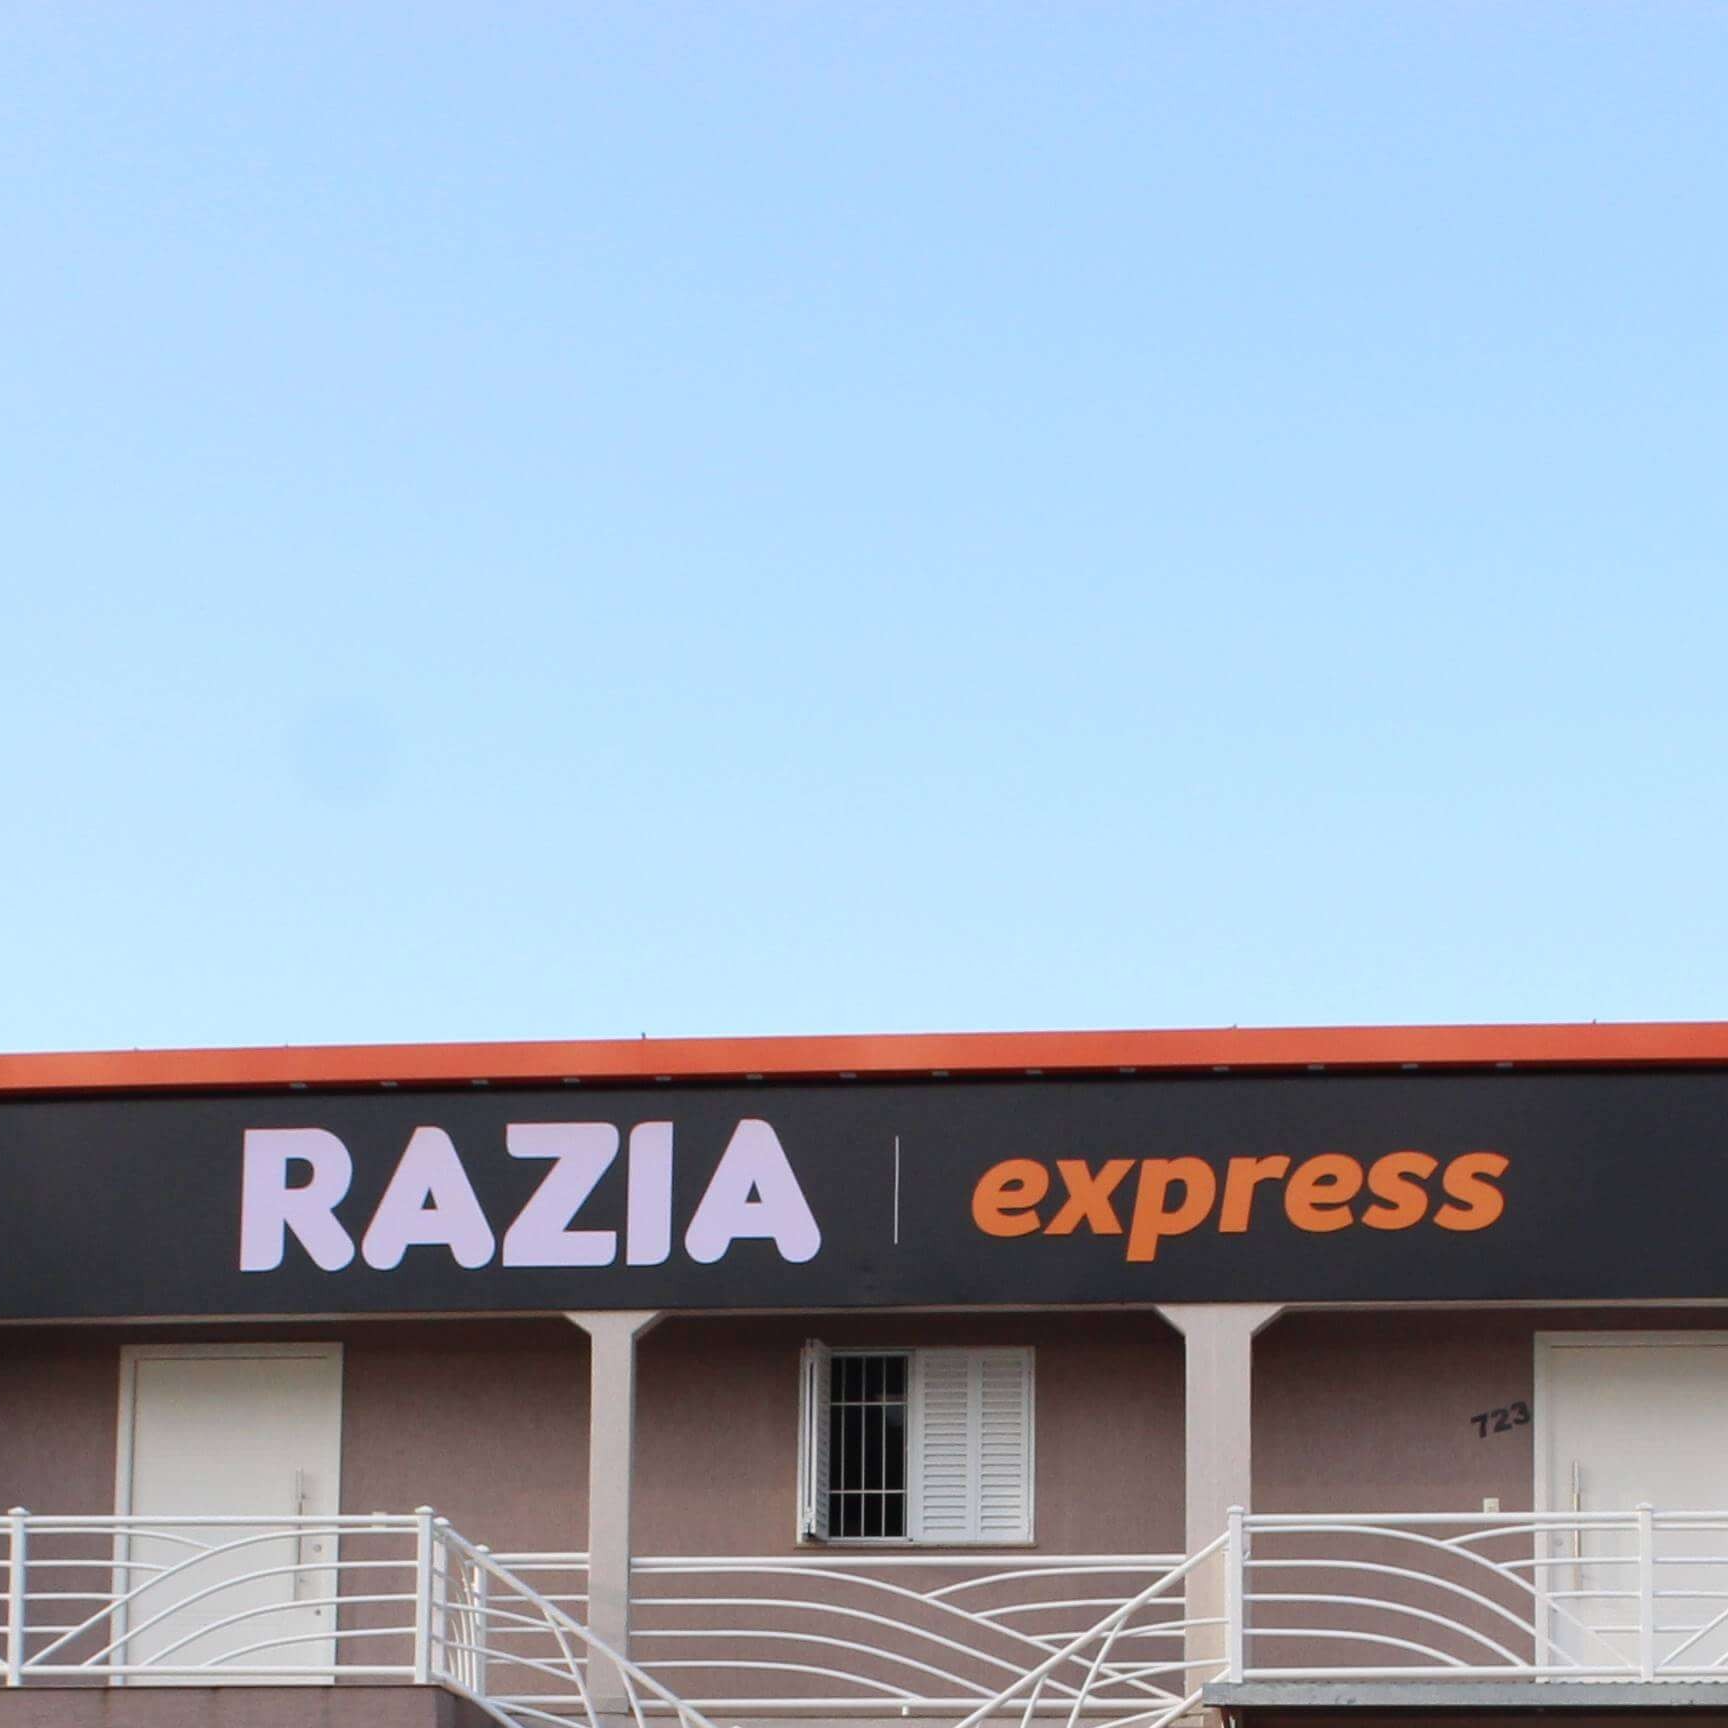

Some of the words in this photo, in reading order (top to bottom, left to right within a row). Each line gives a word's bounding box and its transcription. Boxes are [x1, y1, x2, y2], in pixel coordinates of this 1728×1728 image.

[239, 1118, 822, 1272] RAZIA
[971, 1150, 1511, 1262] express
[1470, 1401, 1531, 1438] 723
